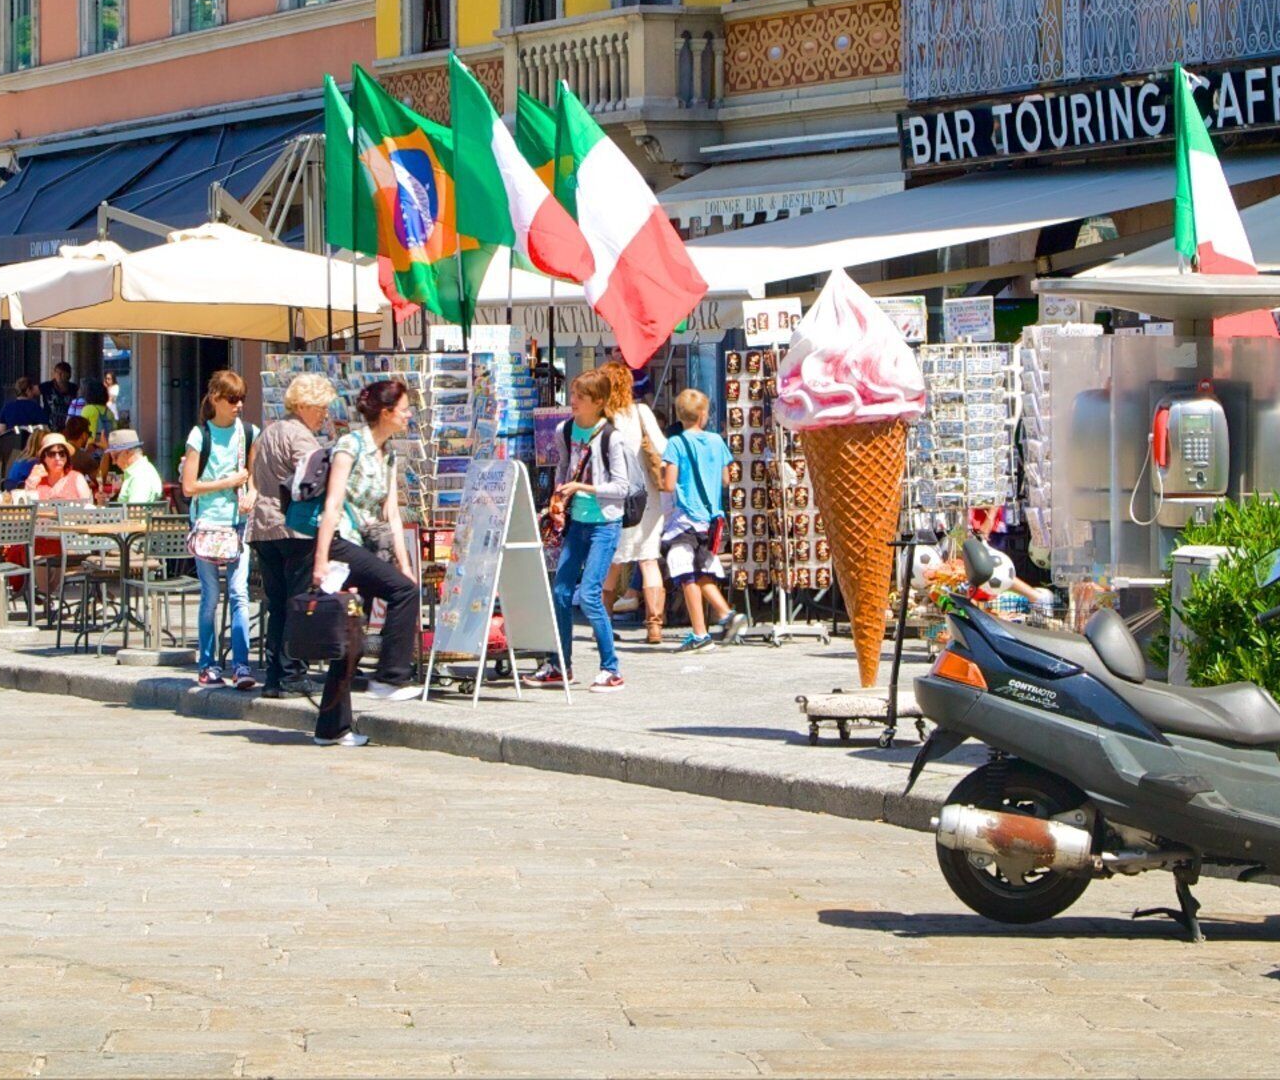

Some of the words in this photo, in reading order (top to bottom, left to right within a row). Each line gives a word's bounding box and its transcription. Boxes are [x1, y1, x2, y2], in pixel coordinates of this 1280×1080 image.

[909, 110, 978, 165] BAR
[992, 82, 1167, 156] TOURING
[704, 198, 741, 215] LOUNGE
[746, 196, 764, 212] BAR
[769, 196, 776, 210] &
[782, 188, 845, 209] RESTAURANT
